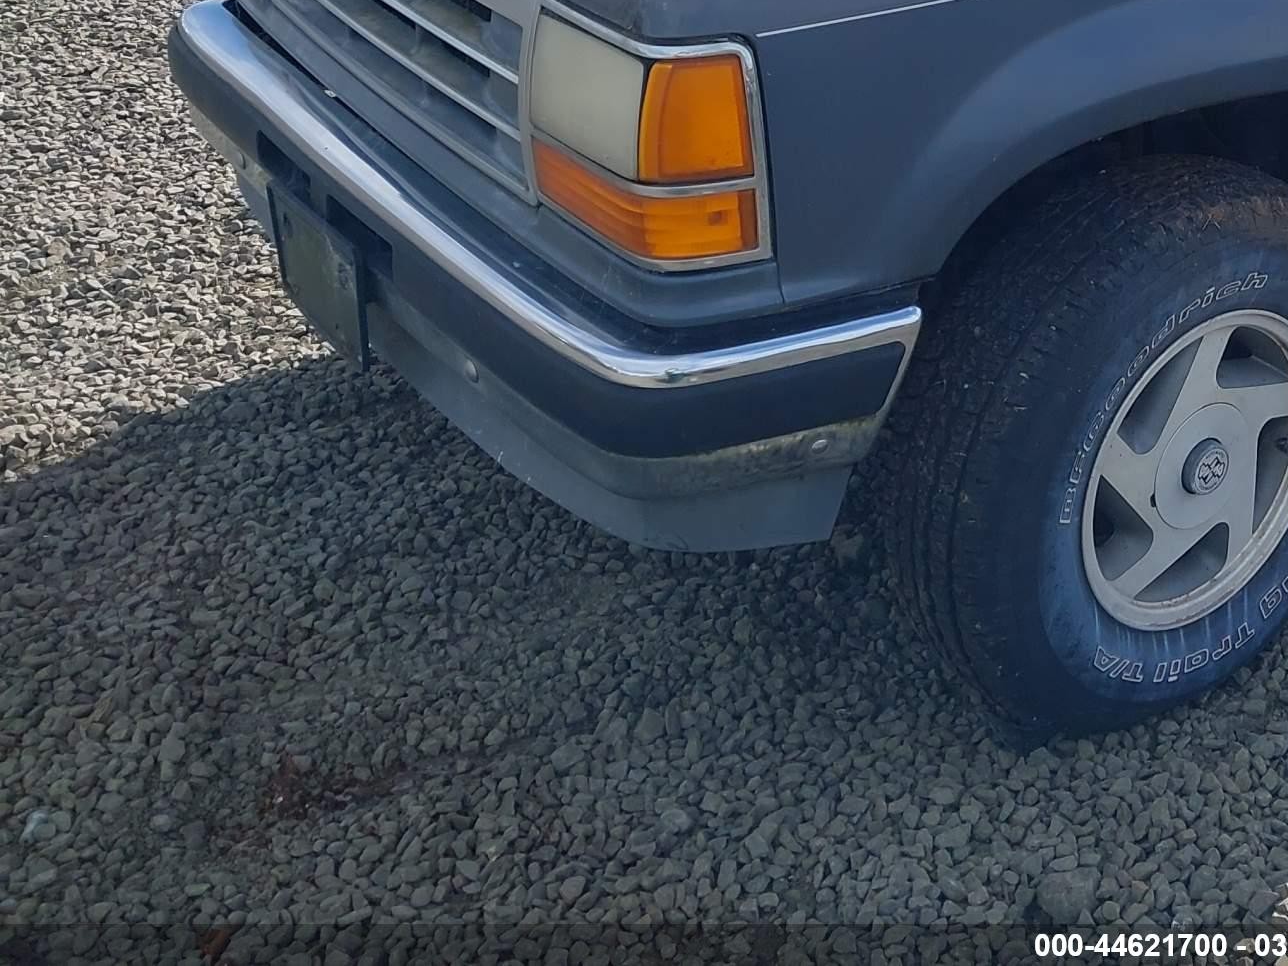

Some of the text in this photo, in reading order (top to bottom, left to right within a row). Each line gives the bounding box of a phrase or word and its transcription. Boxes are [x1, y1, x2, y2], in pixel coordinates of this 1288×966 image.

[1059, 271, 1269, 524] BFGoodrich
[1093, 645, 1144, 683] T/A
[1152, 621, 1256, 683] Trail
